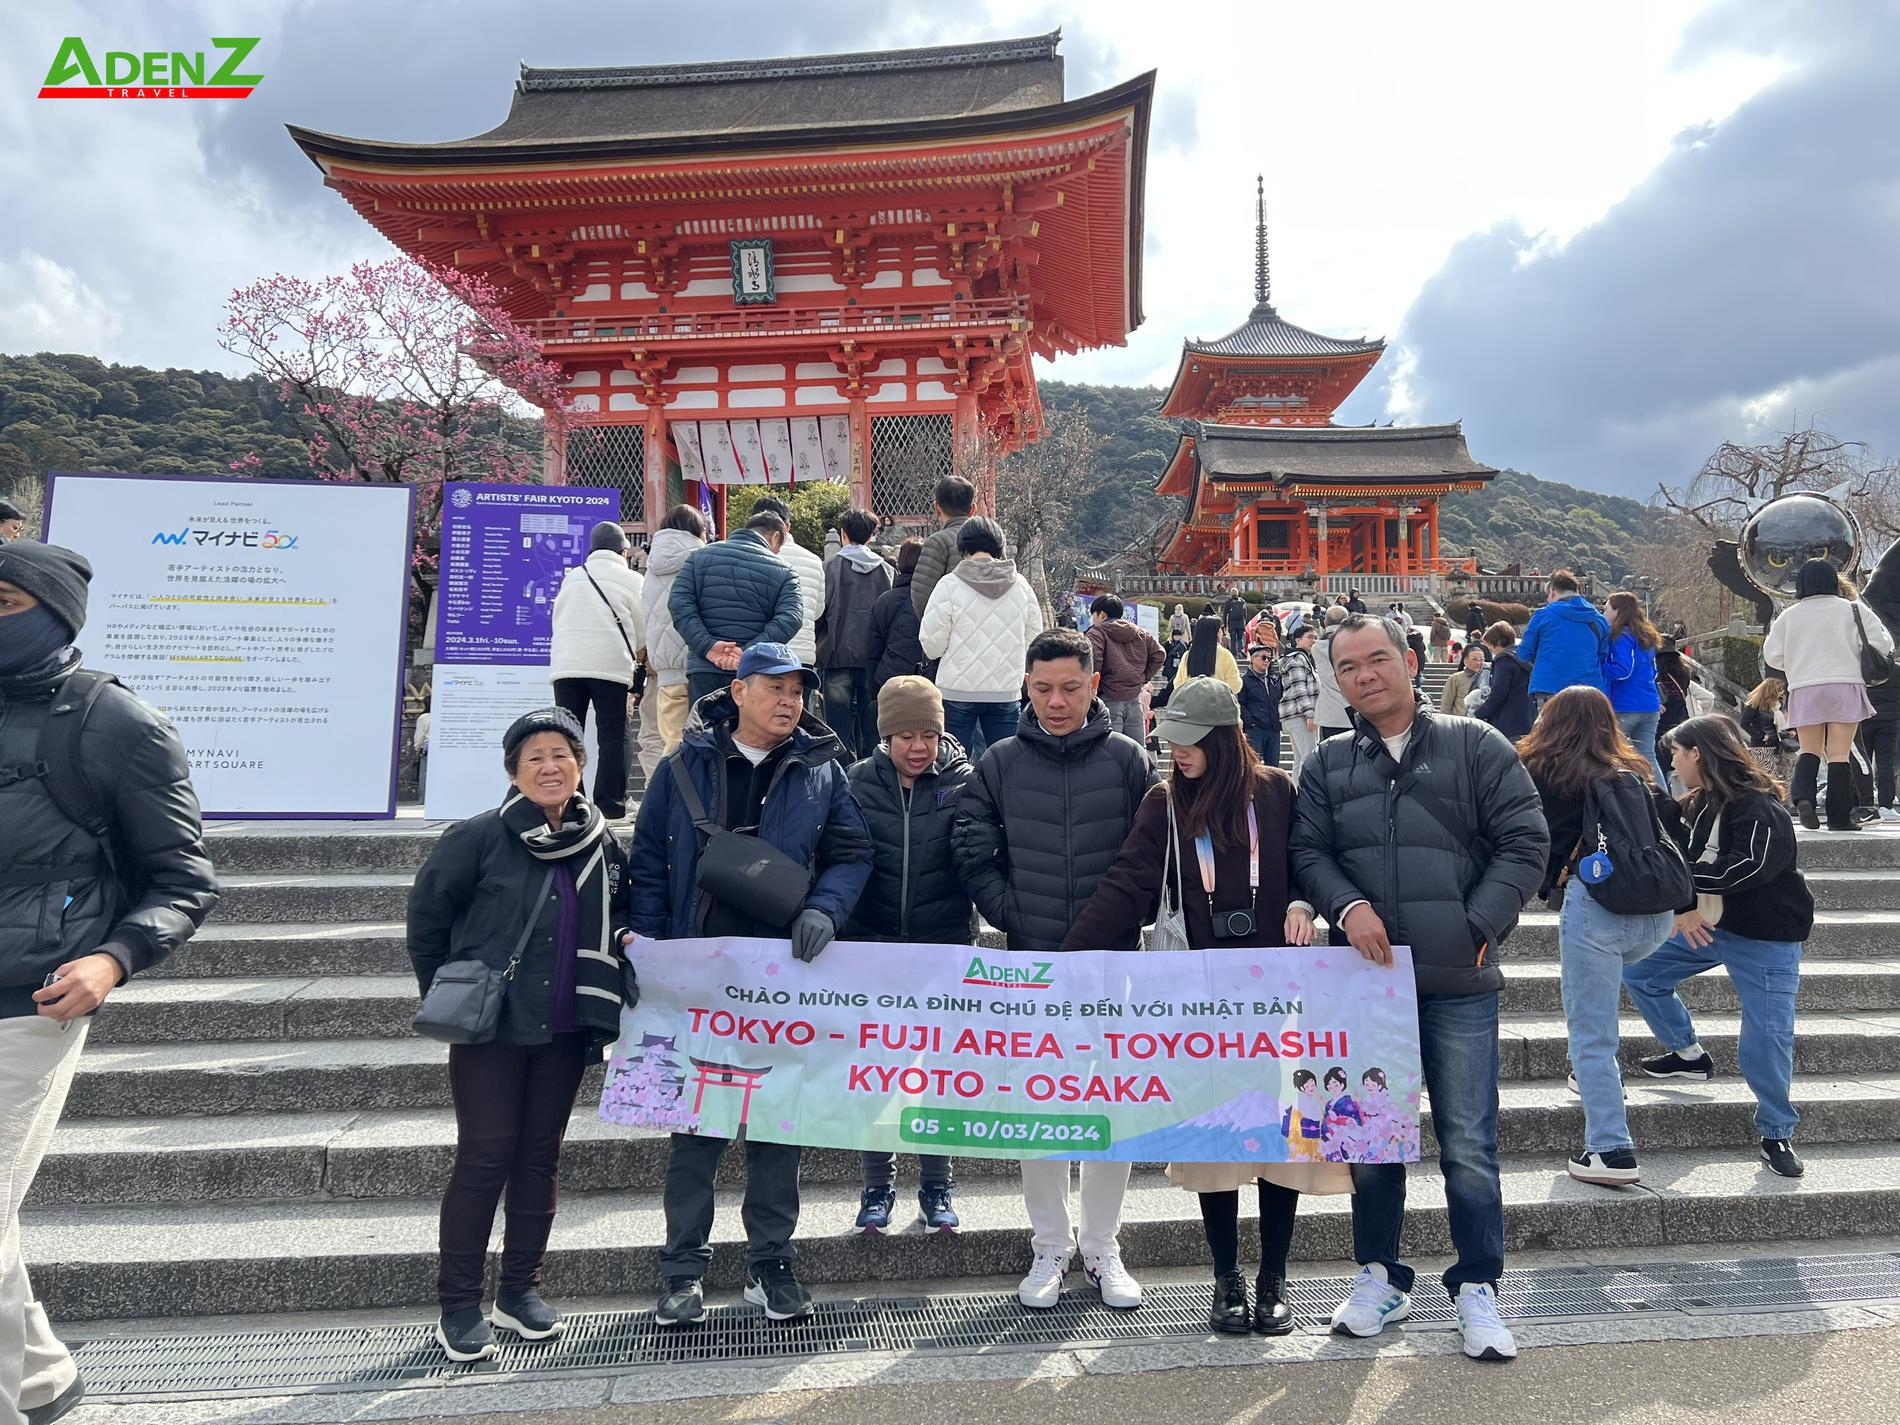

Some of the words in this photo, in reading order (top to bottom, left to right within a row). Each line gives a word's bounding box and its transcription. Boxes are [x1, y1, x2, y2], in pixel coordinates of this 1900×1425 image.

[524, 494, 547, 504] FAIR
[549, 495, 584, 504] KYOTO
[585, 496, 610, 506] 2024
[192, 530, 258, 547] マイナビ
[186, 749, 240, 758] MYNAVI
[188, 760, 211, 769] ART
[213, 760, 264, 770] SQUARE
[725, 985, 791, 1005] CHÀO
[799, 988, 868, 1007] MỪNG
[877, 994, 919, 1010] GIA
[926, 993, 982, 1013] ĐÌNH
[989, 999, 1036, 1016] CHÚ
[1044, 1001, 1073, 1021] ĐỆ
[1080, 998, 1123, 1017] ĐẾN
[1131, 1000, 1173, 1017] VỚI
[1182, 999, 1244, 1020] NHẬT
[1253, 997, 1304, 1015] BẢN
[688, 1008, 815, 1045] TOKYO
[859, 1023, 941, 1052] FUJI
[952, 1028, 1064, 1059] AREA
[1103, 1030, 1348, 1059] TOYOHASHI
[848, 1065, 984, 1098] KYOTO
[1025, 1074, 1172, 1103] OSAKA
[910, 1117, 939, 1135] 05
[962, 1120, 1100, 1142] 10/03/2024
